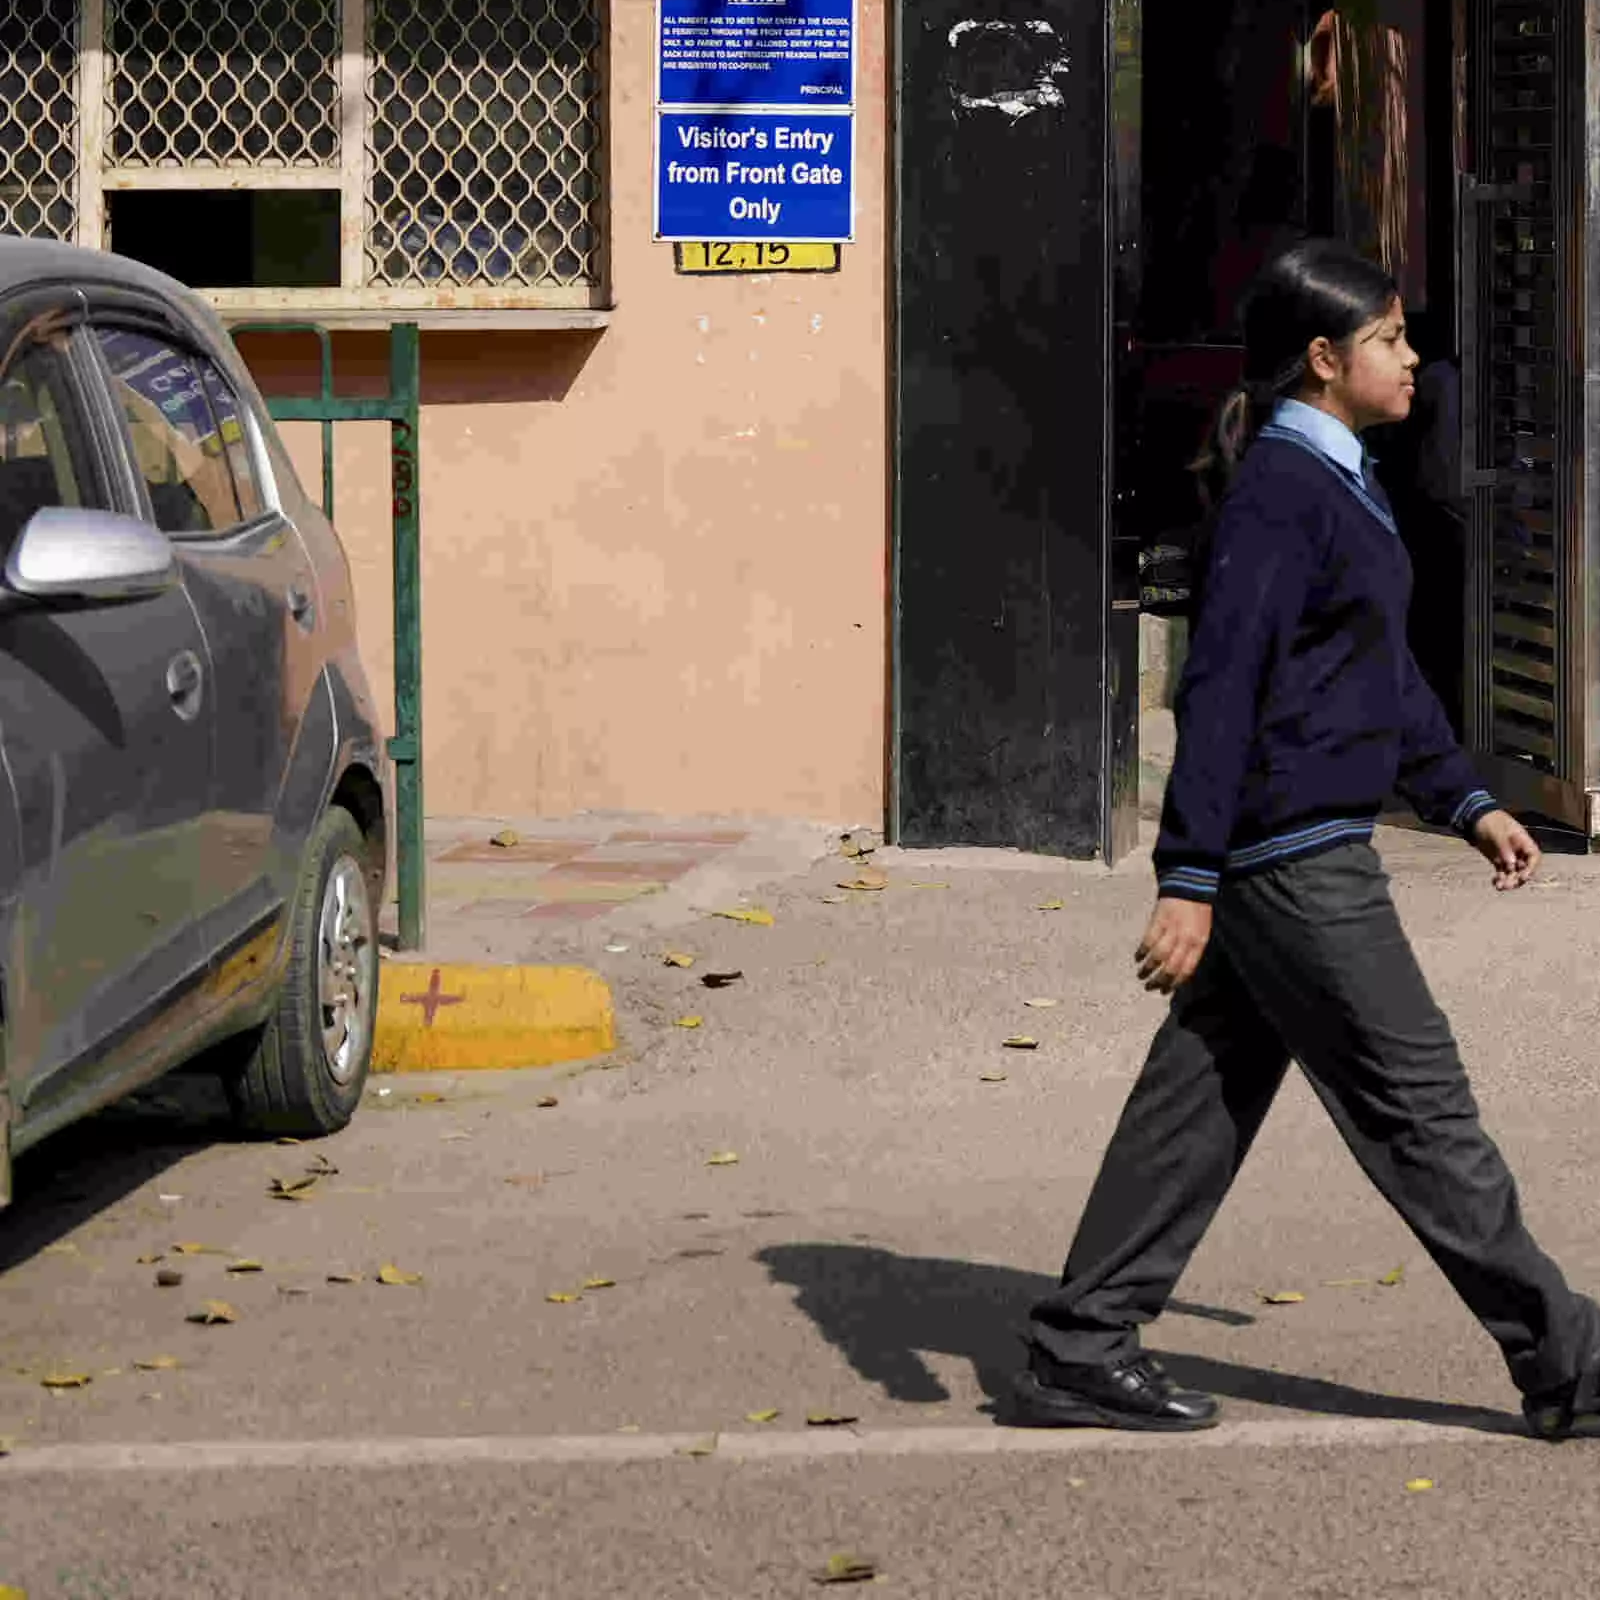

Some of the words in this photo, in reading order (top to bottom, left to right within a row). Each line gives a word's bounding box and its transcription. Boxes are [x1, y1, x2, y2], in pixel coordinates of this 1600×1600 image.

[800, 84, 845, 95] PRINCIPAL
[677, 125, 768, 149] Visitor's
[775, 127, 834, 155] Entry
[667, 160, 719, 184] from
[726, 162, 786, 184] Front
[791, 162, 843, 184] Gate
[729, 196, 782, 224] Only
